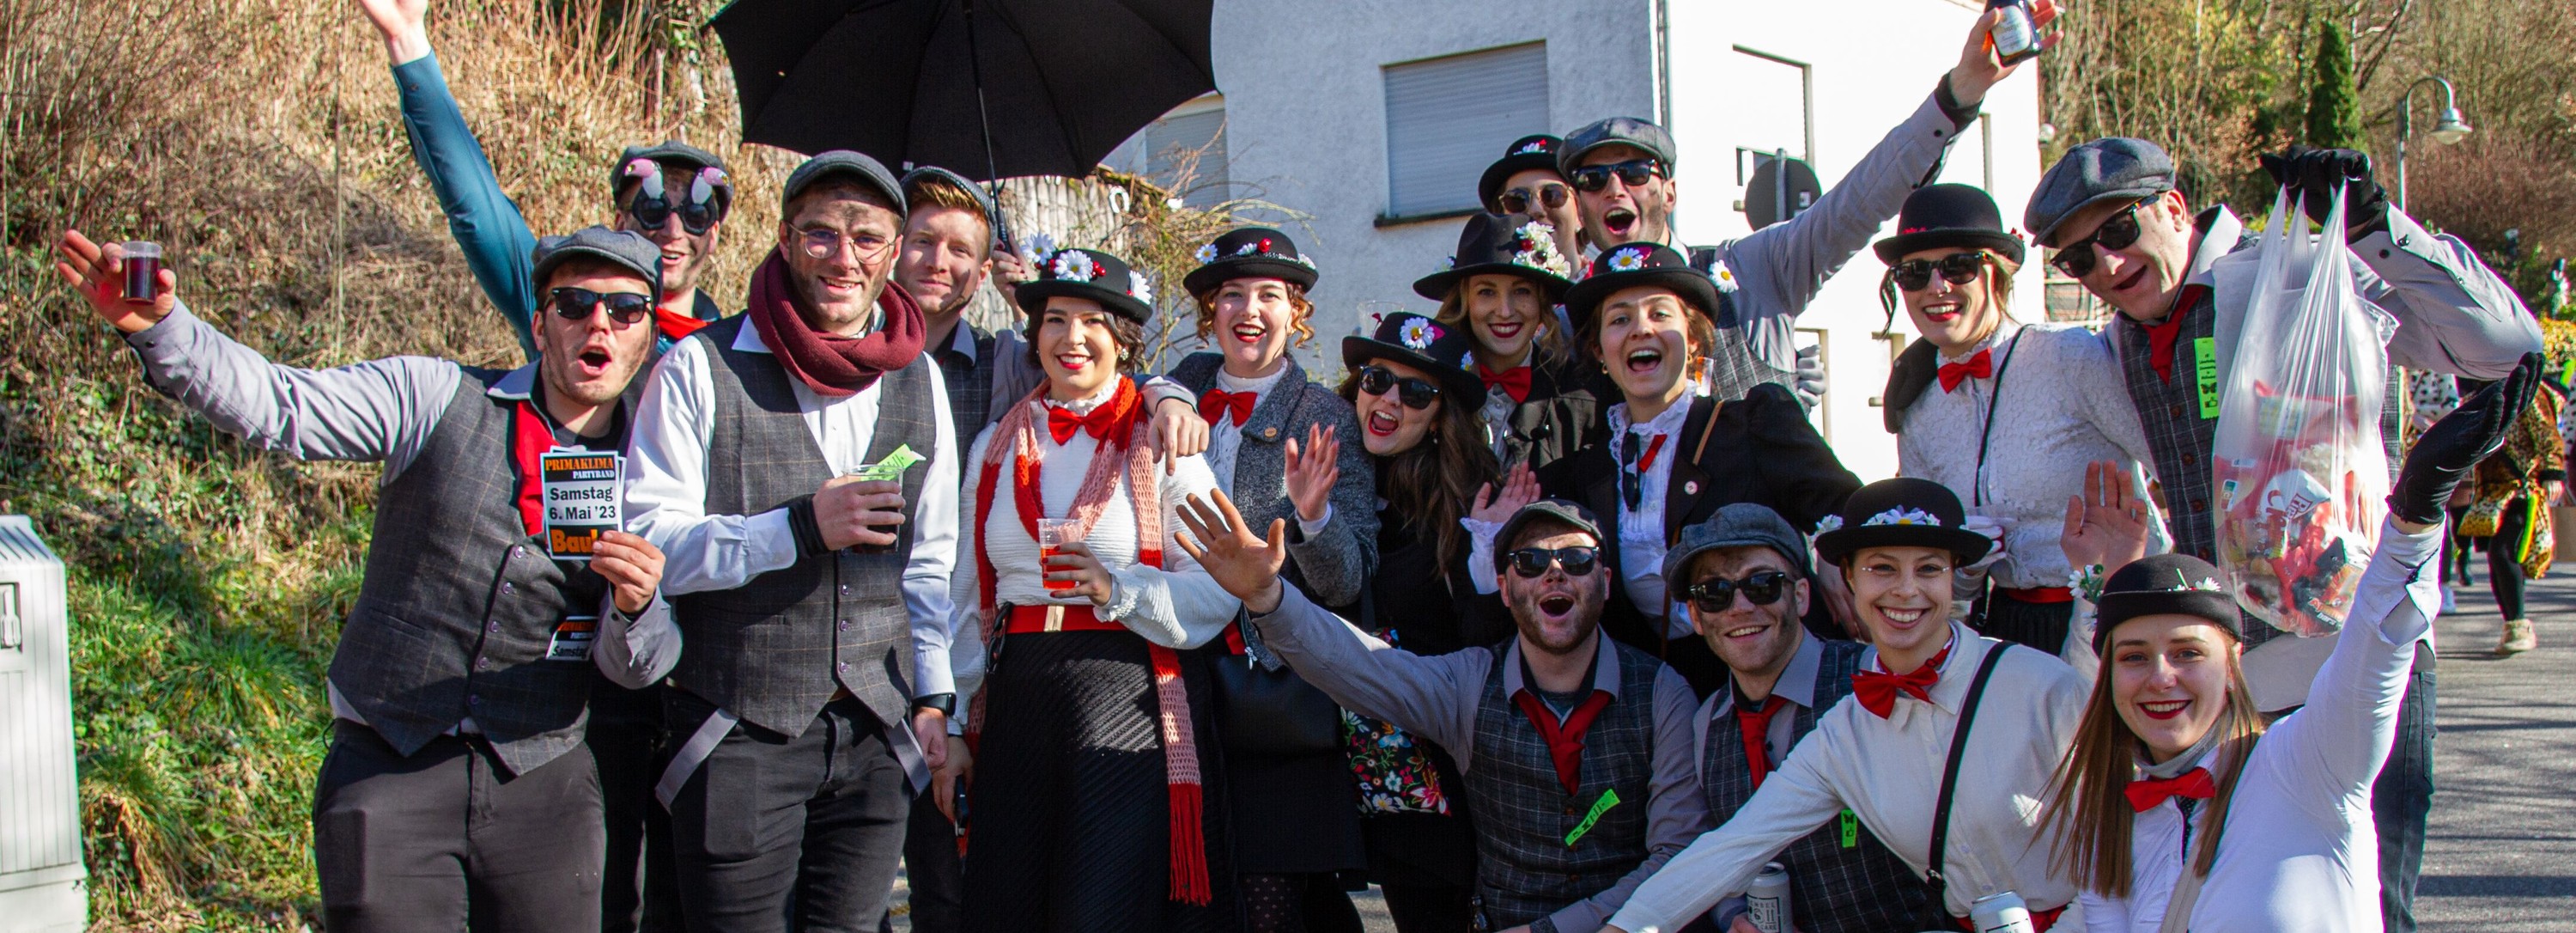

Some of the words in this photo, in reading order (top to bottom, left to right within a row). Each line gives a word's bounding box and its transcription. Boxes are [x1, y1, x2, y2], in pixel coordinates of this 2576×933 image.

[545, 458, 614, 471] PRIMAKLIMA
[573, 470, 615, 479] PARTYBAND
[550, 486, 613, 502] Samstag
[550, 508, 562, 520] 6.
[565, 506, 592, 520] Mai
[595, 505, 617, 519] '23
